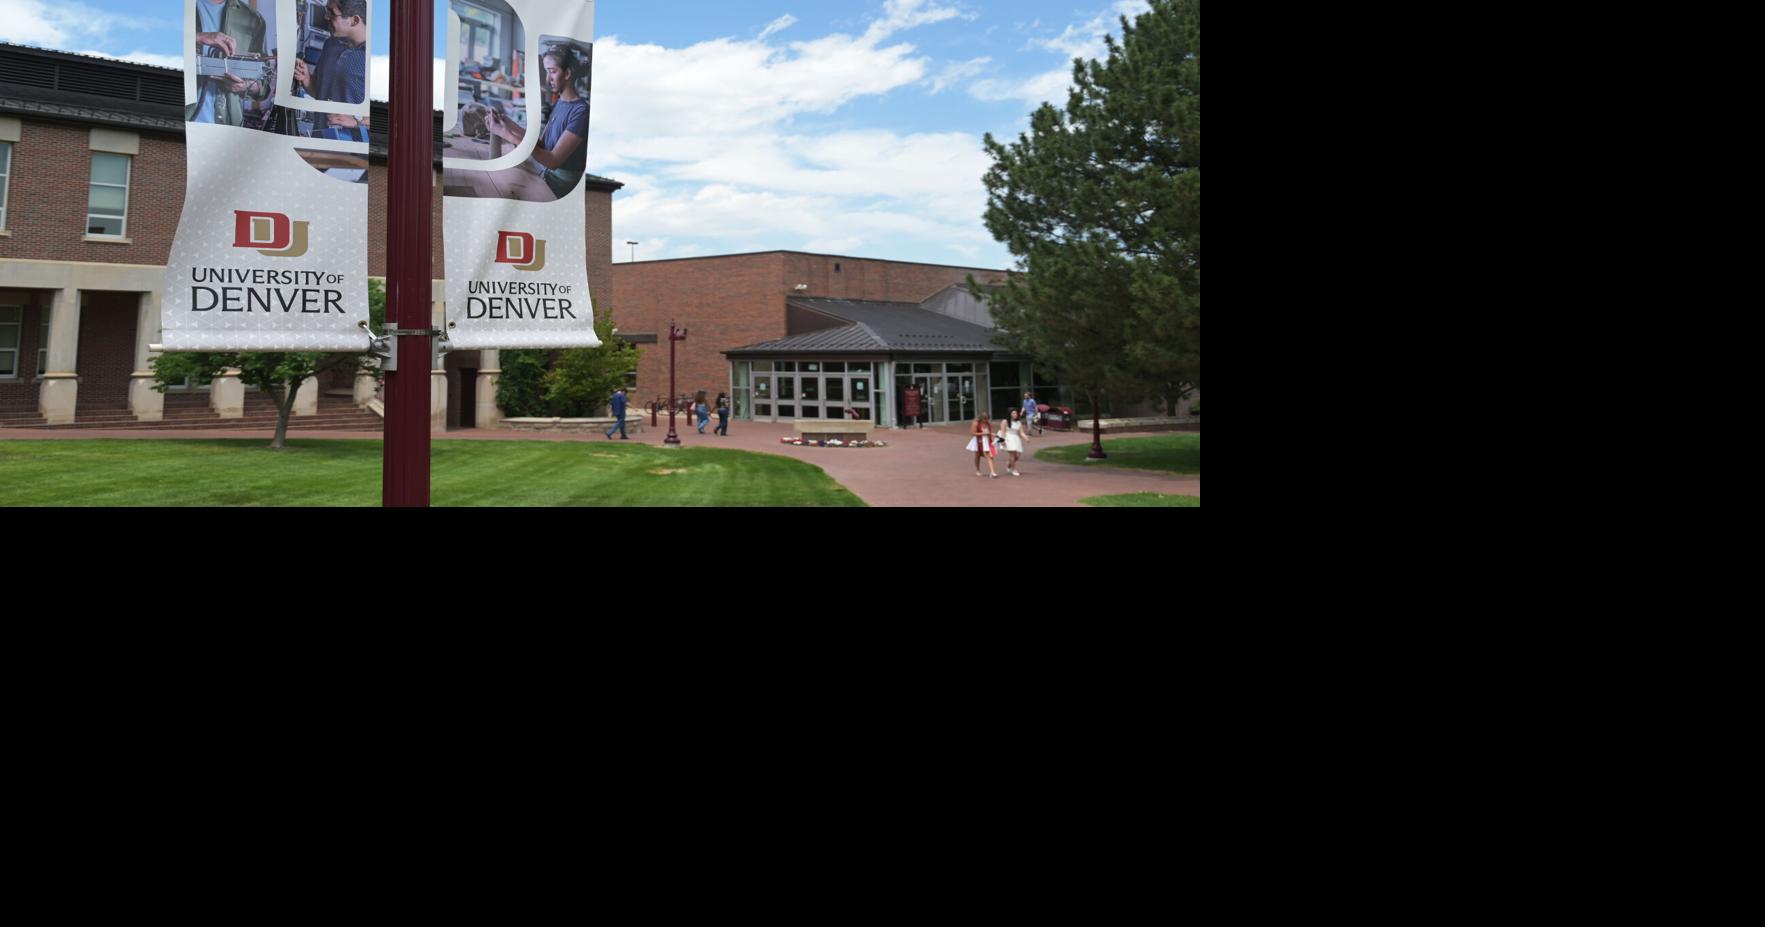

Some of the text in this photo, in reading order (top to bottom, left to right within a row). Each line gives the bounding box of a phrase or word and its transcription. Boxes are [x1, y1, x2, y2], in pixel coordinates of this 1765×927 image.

[233, 210, 309, 257] DU
[495, 230, 546, 271] DU
[191, 267, 345, 286] UNIVERSITY OF
[469, 280, 571, 295] UNIVERSITY OF
[191, 285, 346, 314] DENVER
[466, 297, 577, 320] DENVER
